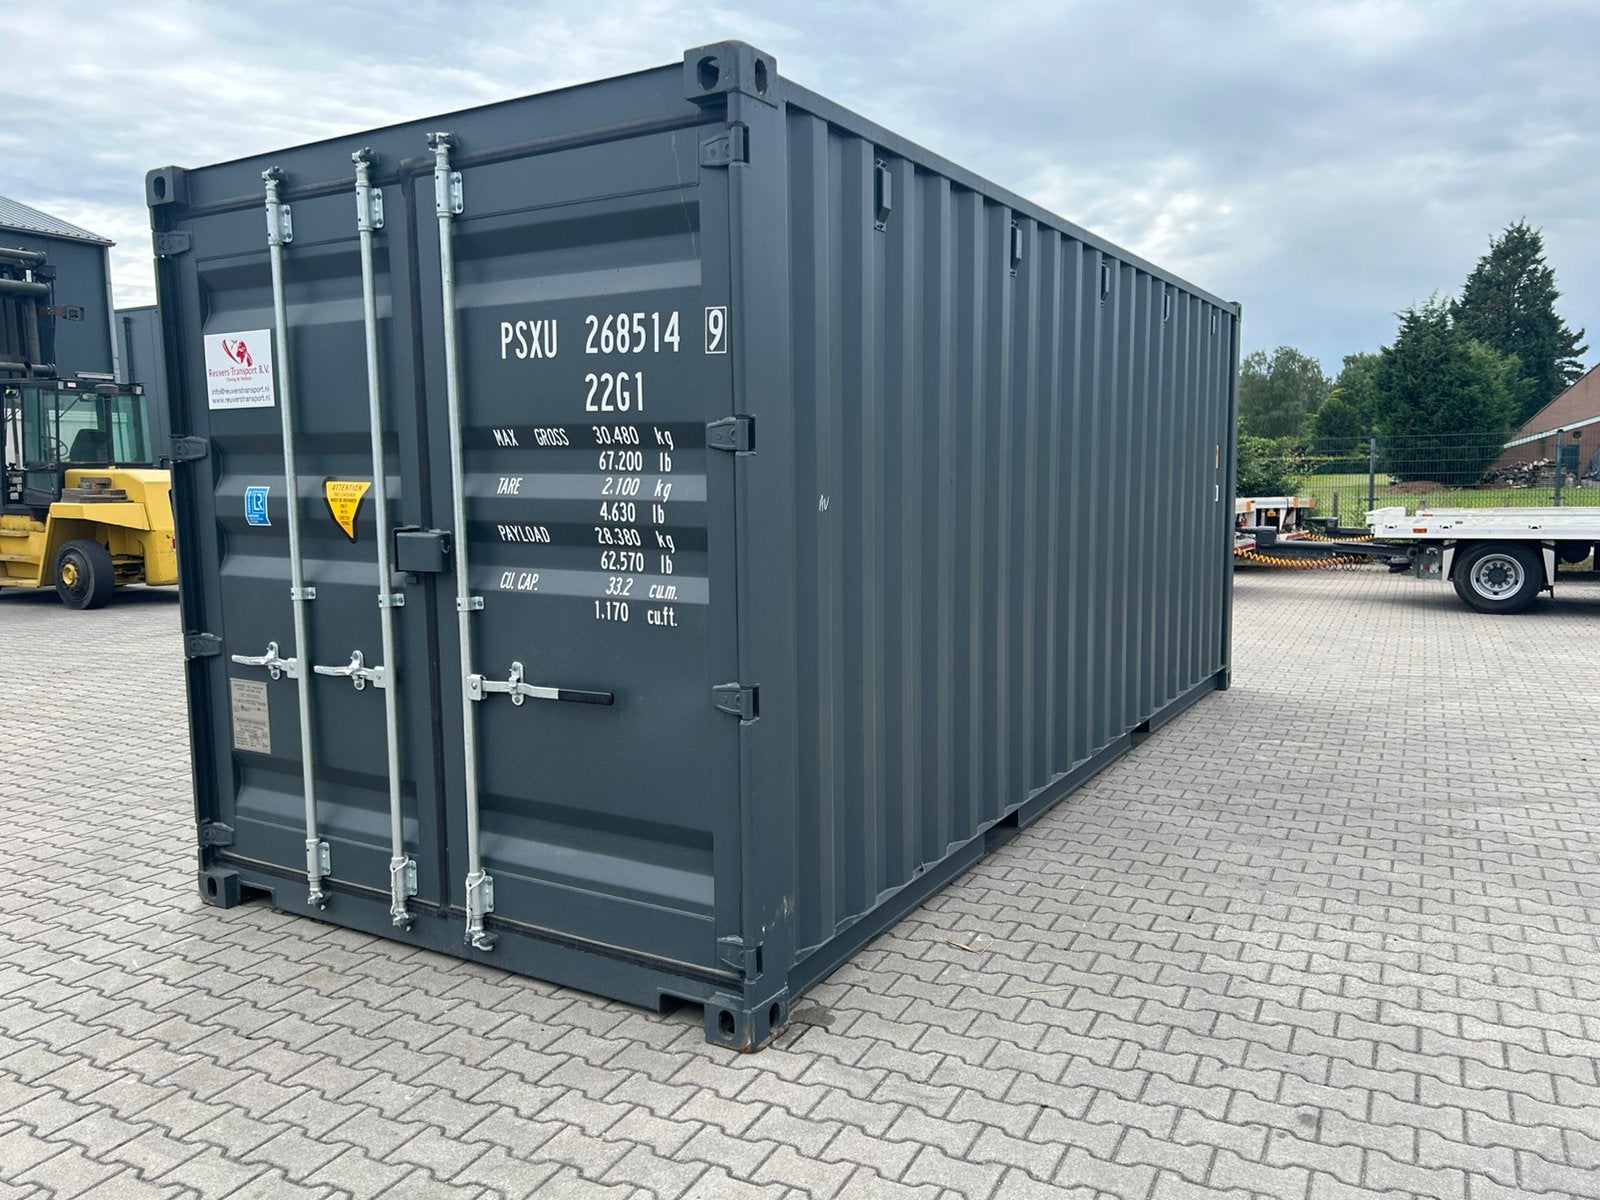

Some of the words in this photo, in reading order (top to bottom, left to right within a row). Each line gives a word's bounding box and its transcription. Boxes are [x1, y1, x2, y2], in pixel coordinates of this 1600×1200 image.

[501, 319, 558, 360] PSXU
[585, 311, 681, 354] 268514
[708, 309, 724, 352] 9
[230, 366, 258, 377] Transport
[584, 371, 644, 412] 22G1
[493, 428, 519, 447] MAX
[533, 428, 570, 447] GROSS
[653, 426, 675, 451] kg
[659, 451, 672, 472] lb
[331, 484, 363, 492] ATTENTION
[496, 477, 523, 495] TARE
[653, 478, 673, 503] kg
[652, 503, 665, 525] lb
[497, 525, 551, 544] PAYLOAD
[654, 530, 676, 554] kg
[660, 554, 673, 575] lb
[605, 576, 634, 597] 33.2
